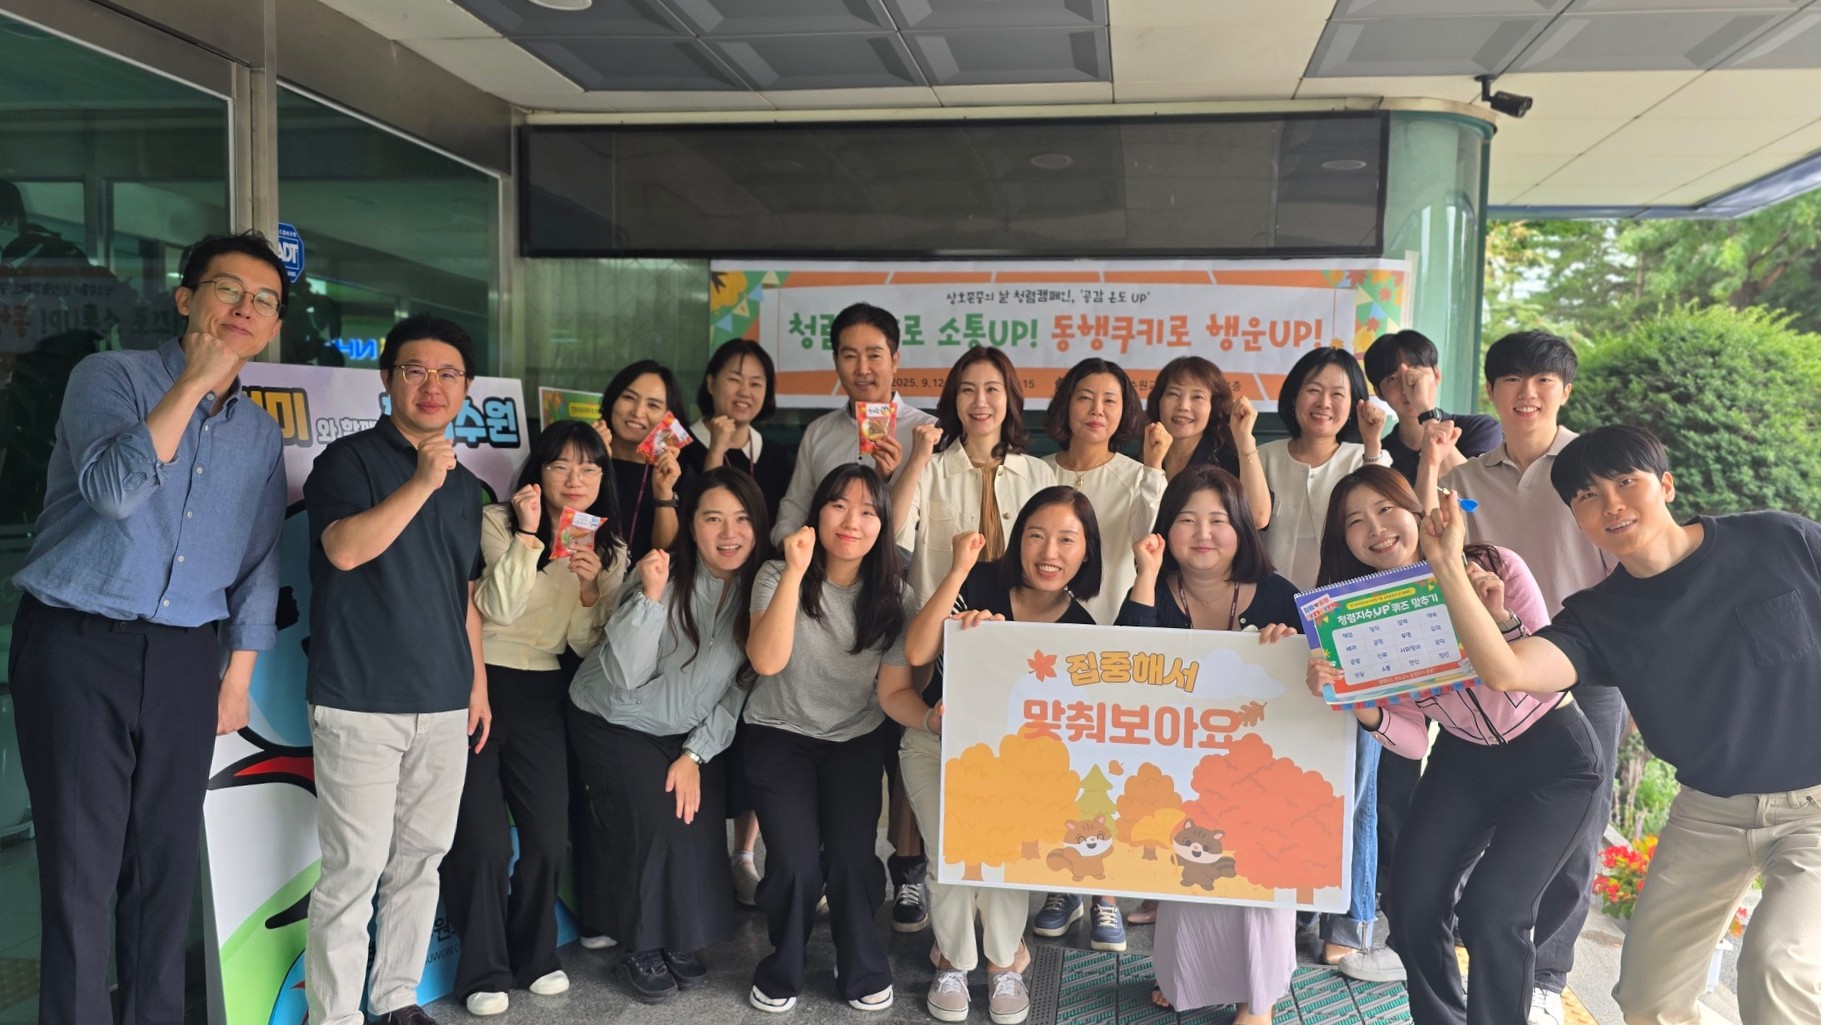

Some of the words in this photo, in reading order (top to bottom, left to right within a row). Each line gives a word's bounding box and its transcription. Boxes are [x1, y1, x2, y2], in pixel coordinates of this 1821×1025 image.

[277, 241, 299, 264] ADT
[946, 290, 995, 305] 상호존중의
[998, 290, 1010, 304] 날
[1108, 291, 1127, 303] 온도
[938, 313, 1039, 348] 소통UP!
[1051, 314, 1192, 354] 동행쿠키로
[1206, 313, 1323, 351] 행운UP!
[1391, 600, 1409, 612] 퀴즈
[1411, 593, 1438, 608] 맞추기
[1065, 651, 1199, 693] 집중해서
[1023, 699, 1242, 750] 맞춰보아요
